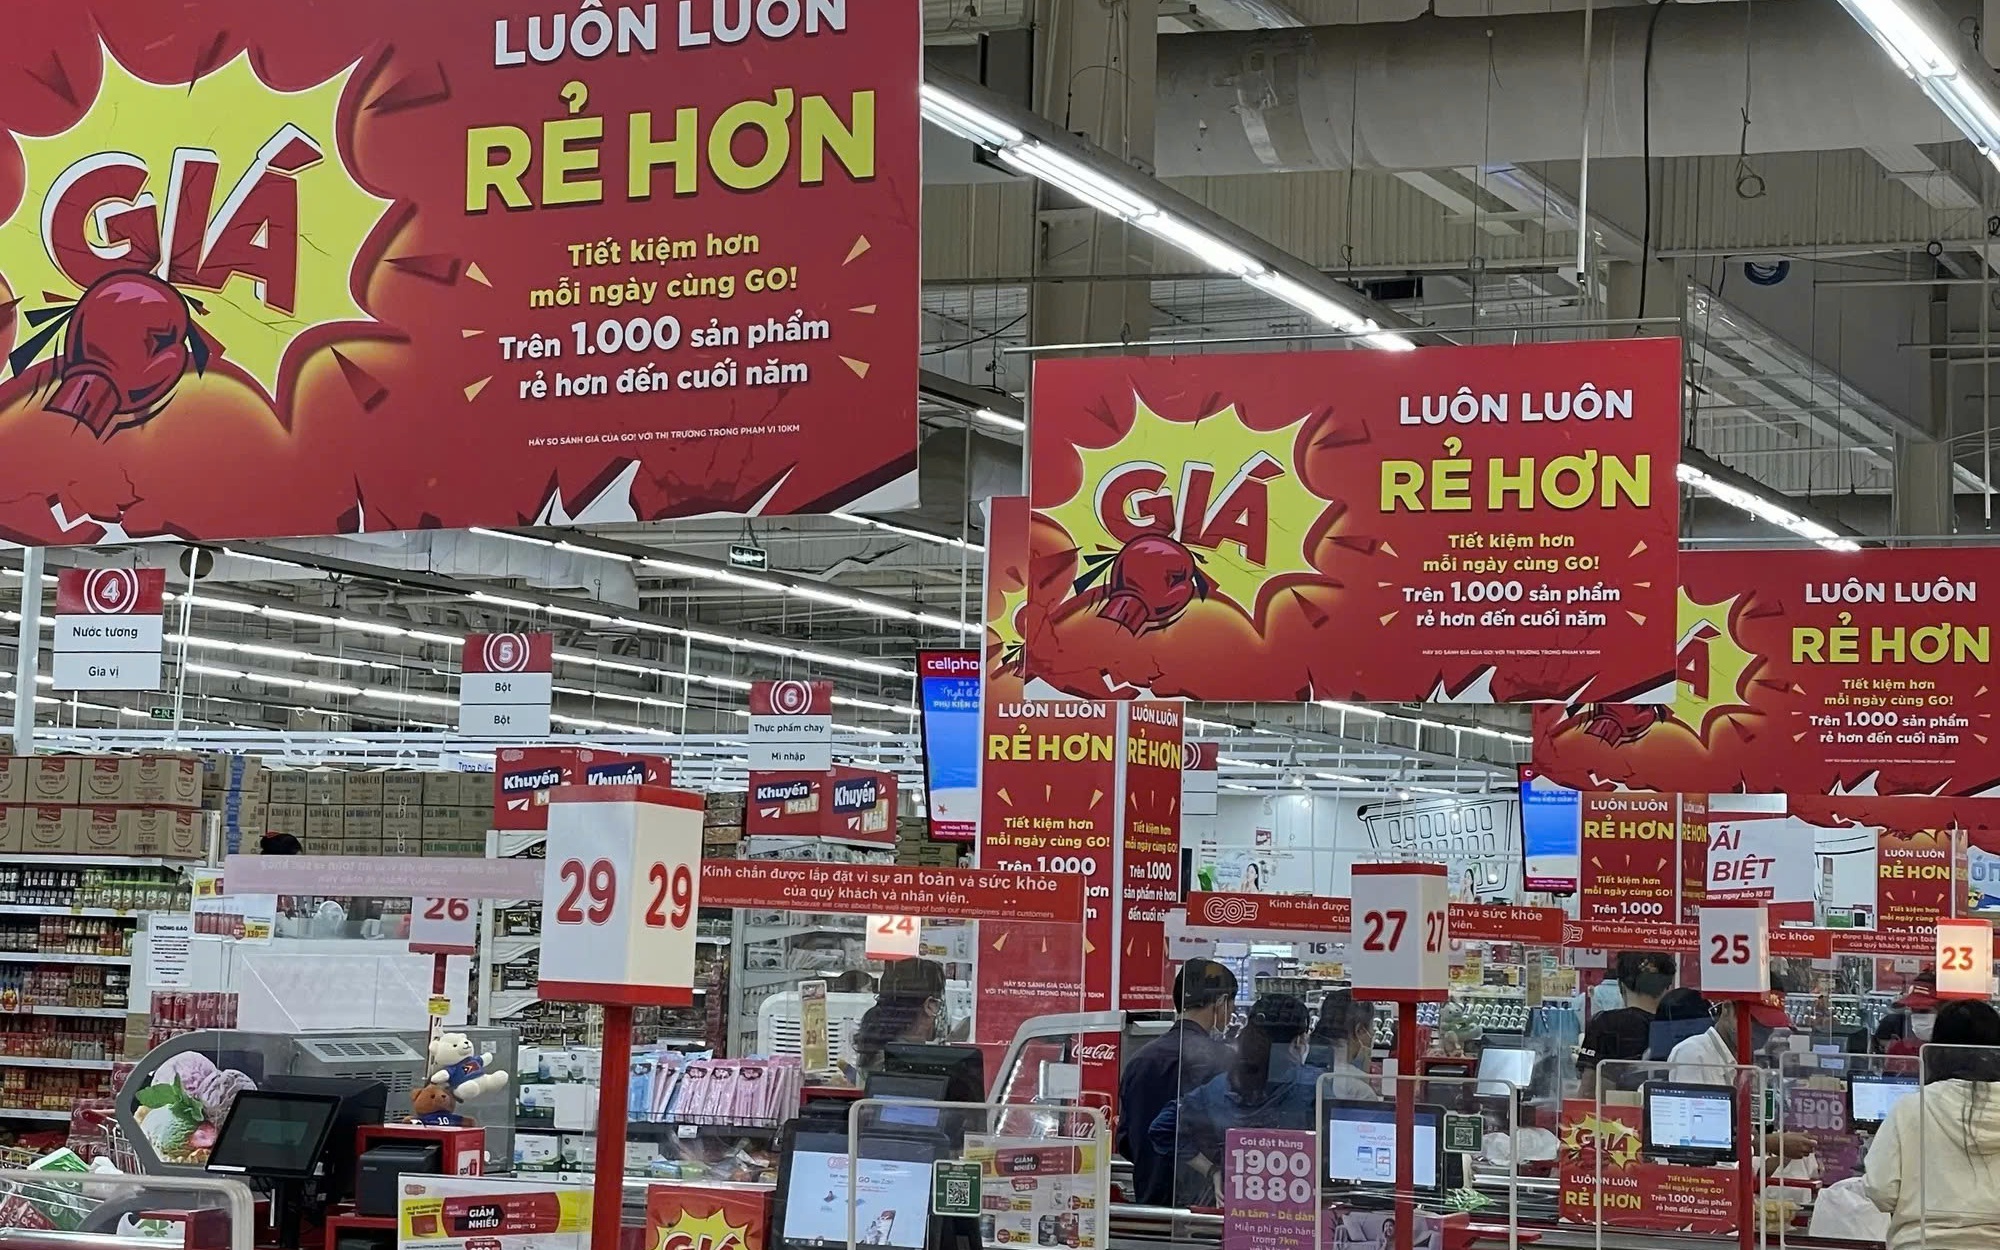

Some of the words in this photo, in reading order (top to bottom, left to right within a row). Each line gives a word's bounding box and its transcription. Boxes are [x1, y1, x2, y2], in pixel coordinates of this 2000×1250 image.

[495, 0, 657, 65] LUÔN
[465, 80, 603, 211] RẺ
[628, 88, 875, 198] HƠN
[42, 123, 323, 315] GIÁ
[568, 237, 621, 267] Tiết
[630, 238, 697, 265] kiệm
[706, 234, 760, 256] hơn
[530, 277, 580, 307] mỗi
[590, 278, 658, 307] ngày
[667, 273, 735, 299] cùng
[745, 266, 798, 291] GO!
[499, 333, 561, 359] Trên
[571, 316, 681, 355] 1.000
[690, 318, 739, 347] sản
[748, 308, 830, 348] phẩm
[519, 371, 547, 399] rẻ
[556, 373, 608, 396] hơn
[616, 362, 669, 393] đến
[677, 358, 737, 389] cuối
[746, 359, 808, 385] năm
[1400, 386, 1508, 424] LUÔN
[1521, 382, 1633, 422] LUÔN
[1380, 436, 1472, 511] RẺ
[1488, 449, 1650, 509] HƠN
[1094, 450, 1285, 568] GIÁ
[1448, 532, 1484, 548] Tiết
[1490, 534, 1533, 551] kiệm
[1539, 533, 1574, 547] hơn
[1423, 554, 1457, 572] mỗi
[1462, 558, 1507, 573] ngày
[1513, 555, 1559, 573] cùng
[1565, 555, 1599, 570] GO!
[101, 578, 119, 603] 4
[1402, 586, 1444, 602] Trên
[1450, 581, 1523, 602] 1.000
[1529, 583, 1561, 601] sản
[1566, 581, 1620, 603] phẩm
[1805, 577, 1885, 603] LUÔN
[1895, 576, 1976, 602] LUÔN
[1416, 609, 1435, 626] rẻ
[1440, 610, 1475, 626] hơn
[1480, 606, 1515, 626] đến
[1520, 605, 1560, 626] cuối
[1565, 608, 1606, 626] năm
[72, 626, 102, 637] Nước
[105, 626, 138, 639] tương
[1792, 612, 1860, 663] RẺ
[1871, 622, 1990, 664] HƠN
[499, 642, 513, 663] 5
[88, 665, 106, 677] Gia
[109, 665, 119, 679] vị
[927, 657, 981, 673] cellpho
[494, 682, 512, 695] Bột
[1842, 678, 1869, 689] Tiết
[1873, 679, 1905, 691] kiệm
[1909, 679, 1935, 689] hơn
[784, 688, 798, 707] 6
[1824, 692, 1849, 705] mỗi
[1853, 696, 1886, 707] ngày
[1890, 694, 1924, 707] cùng
[1928, 695, 1953, 706] GO!
[998, 700, 1049, 718] LUÔN
[1054, 701, 1106, 718] LUÔN
[1132, 705, 1155, 723] LUÔN
[1156, 708, 1178, 727] LUÔN
[493, 714, 511, 728] Bột
[1809, 714, 1840, 726] Trên
[1844, 711, 1898, 726] 1.000
[1902, 713, 1926, 726] sản
[1929, 713, 1969, 729] phẩm
[988, 723, 1031, 760] RẺ
[1038, 732, 1113, 761] HƠN
[1820, 730, 1834, 743] rẻ
[1837, 731, 1863, 743] hơn
[1866, 730, 1893, 743] đến
[1896, 729, 1926, 744] cuối
[1929, 732, 1959, 744] năm
[1127, 728, 1147, 765] RẺ
[1149, 739, 1181, 769] HƠN
[503, 769, 559, 790] Khuyến
[757, 783, 808, 800] Khuyến
[834, 780, 876, 808] Khuyến
[1591, 798, 1627, 810] LUÔN
[1631, 799, 1668, 811] LUÔN
[1004, 816, 1030, 829] Tiết
[1033, 817, 1064, 831] kiệm
[1068, 819, 1094, 829] hơn
[1584, 814, 1615, 838] RẺ
[1620, 820, 1674, 840] HƠN
[986, 832, 1011, 845] mỗi
[1014, 836, 1046, 848] ngày
[1050, 835, 1082, 848] cùng
[1086, 836, 1110, 847] GO!
[1885, 849, 1914, 857] LUÔN
[1916, 849, 1945, 858] LUÔN
[1037, 856, 1096, 875] 1.000
[1712, 854, 1776, 885] BIỆT
[1879, 860, 1904, 878] RẺ
[1907, 865, 1950, 880] HƠN
[771, 867, 805, 881] được
[809, 867, 829, 882] lắp
[832, 869, 853, 883] đặt
[857, 871, 868, 883] vì
[872, 874, 890, 885] sự
[893, 873, 913, 884] an
[918, 872, 955, 887] toàn
[959, 876, 975, 887] và
[978, 874, 1011, 889] sức
[1016, 875, 1057, 891] khỏe
[555, 857, 618, 927] 29
[644, 862, 694, 932] 29
[783, 885, 806, 897] của
[810, 885, 834, 900] quý
[838, 886, 878, 900] khách
[882, 888, 897, 900] và
[901, 889, 934, 902] nhân
[938, 892, 969, 904] viên.
[424, 898, 469, 921] 26
[1592, 904, 1618, 914] Trên
[1620, 901, 1663, 915] 1.000
[878, 915, 914, 935] 24
[1362, 910, 1409, 952] 27
[1426, 910, 1445, 954] 27
[1711, 934, 1751, 964] 25
[1942, 946, 1974, 970] 23
[1231, 1148, 1311, 1178] 1900
[1230, 1175, 1311, 1204] 1880
[1612, 1177, 1638, 1188] LUÔN
[1603, 1193, 1642, 1210] HƠN
[1668, 1194, 1696, 1204] 1.000
[468, 1215, 499, 1229] NHIỀU
[469, 1206, 495, 1218] GIẢM
